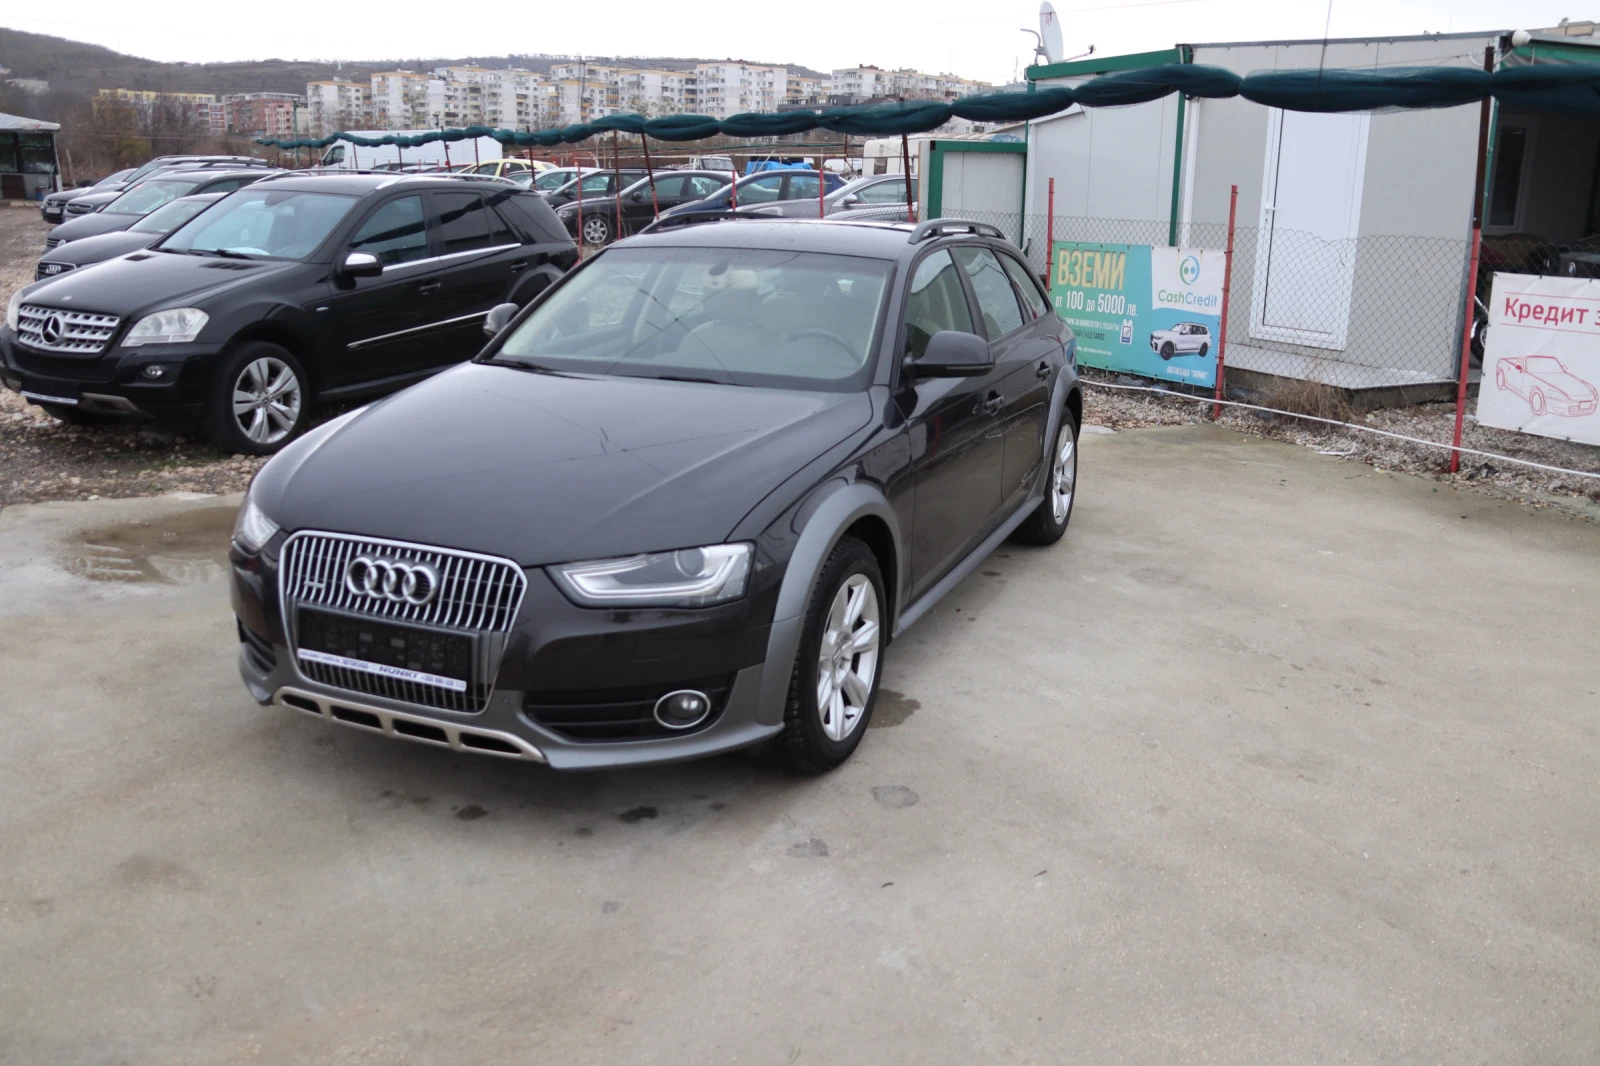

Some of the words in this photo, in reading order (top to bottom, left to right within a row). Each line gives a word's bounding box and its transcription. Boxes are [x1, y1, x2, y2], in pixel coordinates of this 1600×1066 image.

[1058, 248, 1126, 291] ВЗЕМИ
[1066, 290, 1084, 310] 100
[1097, 293, 1125, 315] 5000
[1158, 289, 1218, 307] CashCredit
[1504, 297, 1589, 326] Кредит
[380, 666, 418, 679] NUNKI
